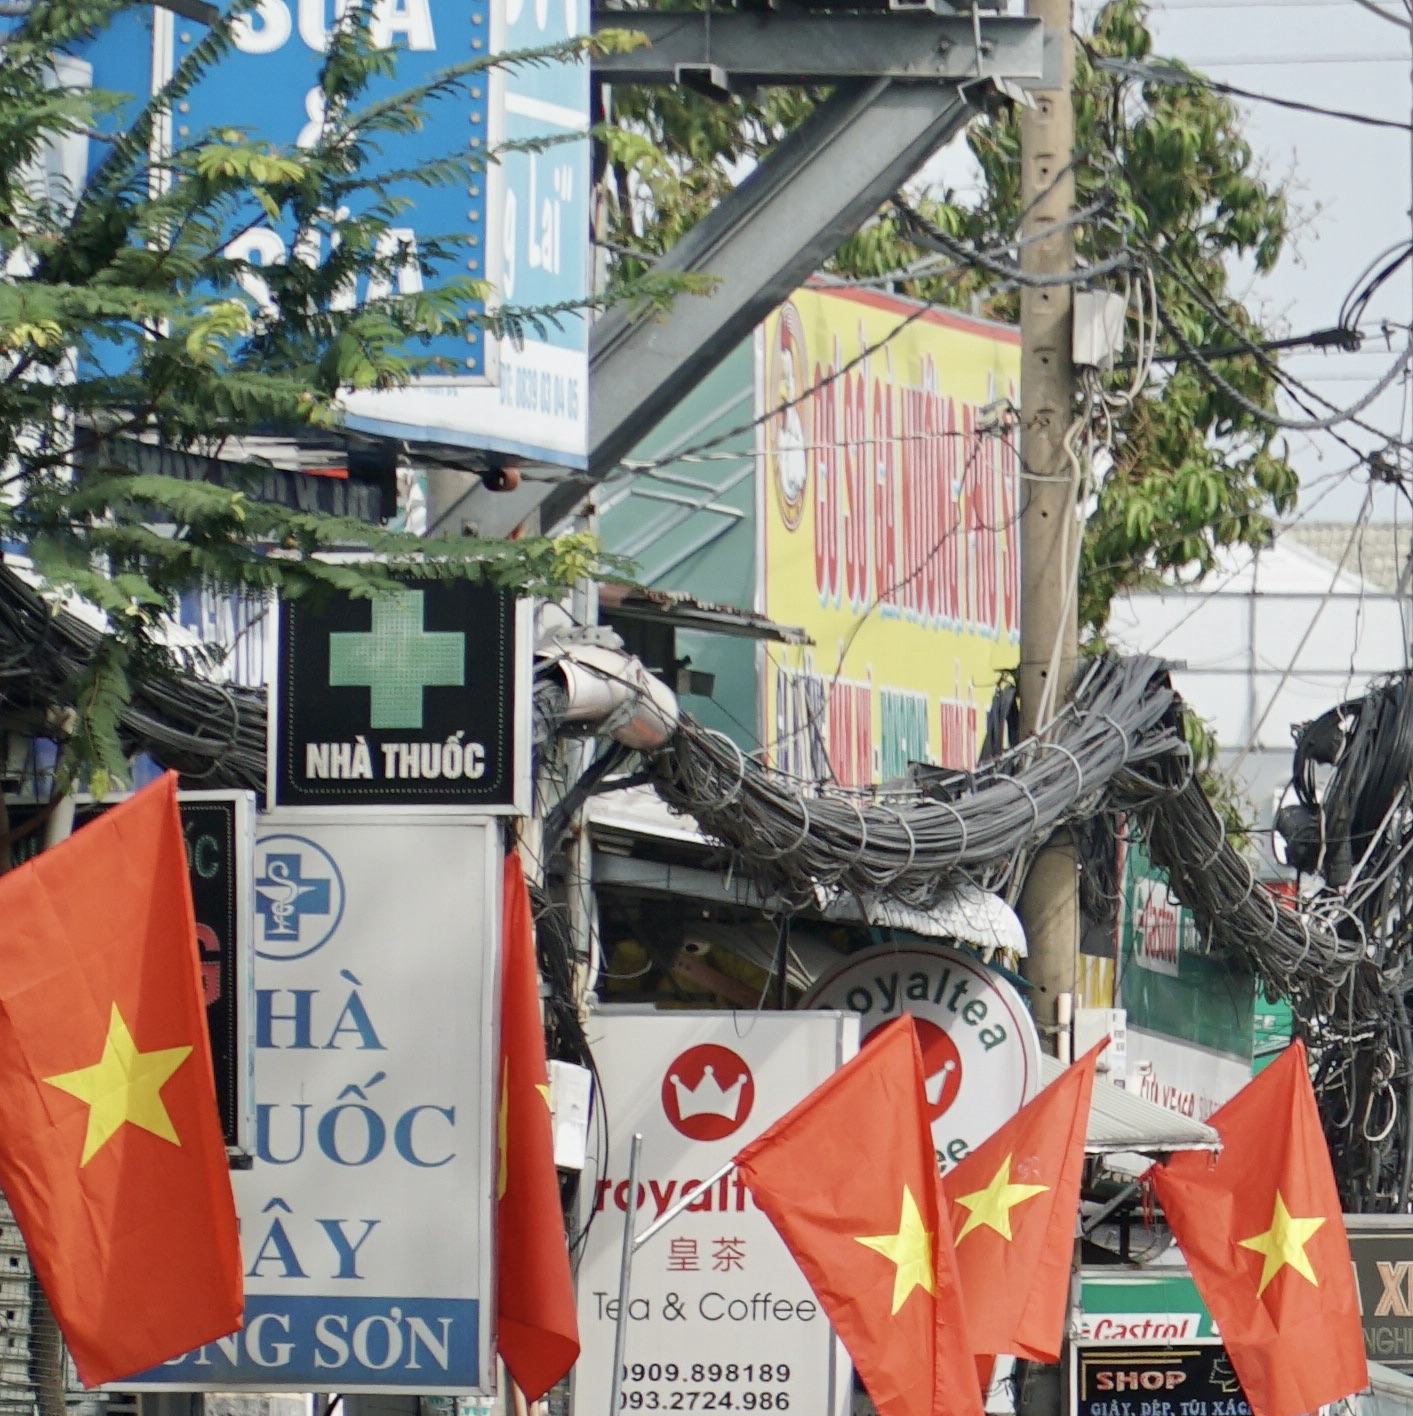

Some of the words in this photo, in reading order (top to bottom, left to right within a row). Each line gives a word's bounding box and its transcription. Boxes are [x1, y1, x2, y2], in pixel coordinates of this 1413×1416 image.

[307, 735, 373, 780] NHÀ
[382, 730, 485, 779] THUỐC
[255, 968, 388, 1050] HÀ
[818, 966, 1008, 1053] oyaltea
[256, 1072, 456, 1168] UỐC
[595, 1171, 749, 1223] royalt
[243, 1197, 381, 1280] ÂY
[666, 1236, 746, 1272] 皇茶
[593, 1291, 650, 1321] Tea
[662, 1292, 687, 1321] &
[698, 1291, 817, 1322] Coffee
[1093, 1318, 1190, 1340] Castrol
[314, 1306, 454, 1371] SƠN
[1095, 1370, 1188, 1392] SHOP
[1213, 1400, 1252, 1416] XÁC
